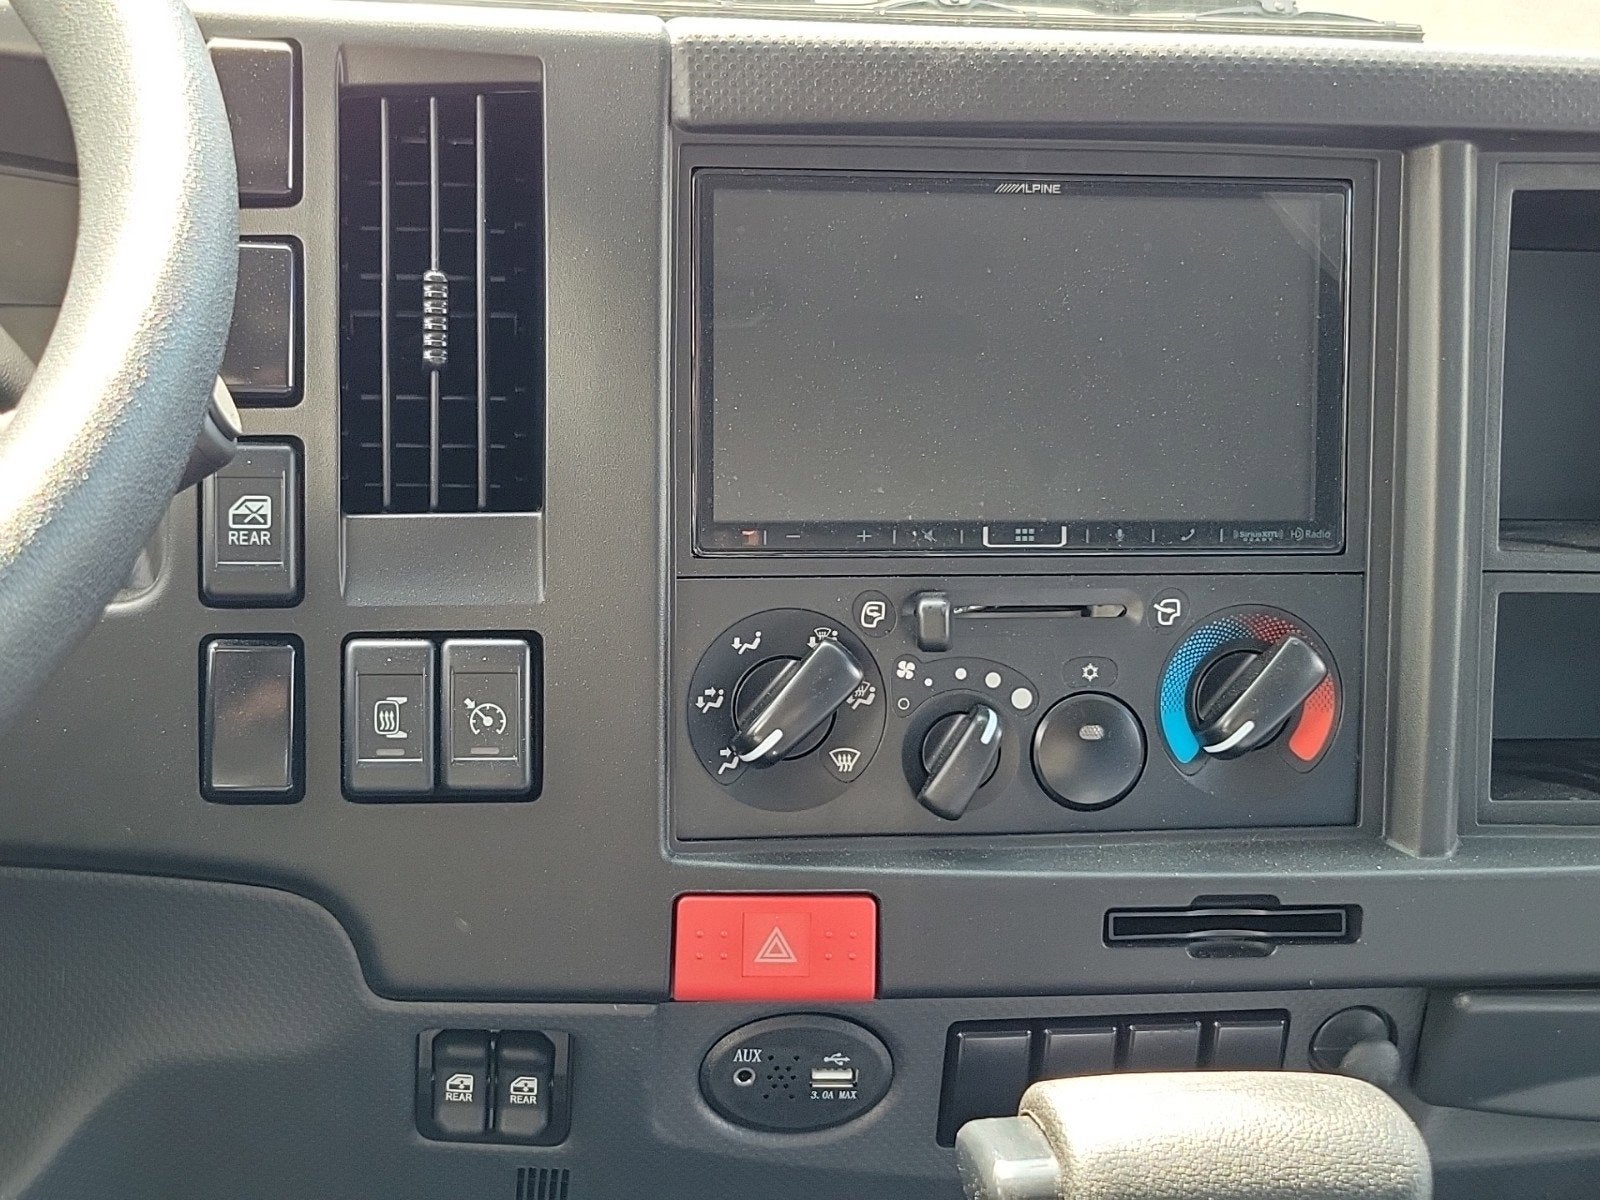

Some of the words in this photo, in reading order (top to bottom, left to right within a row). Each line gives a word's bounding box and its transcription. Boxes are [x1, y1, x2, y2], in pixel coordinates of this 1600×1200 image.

[228, 530, 272, 546] REAR
[1305, 529, 1331, 539] Radio
[733, 1048, 763, 1063] AUX
[445, 1091, 473, 1103] REAR
[510, 1094, 538, 1105] REAR
[838, 1090, 858, 1100] MAX
